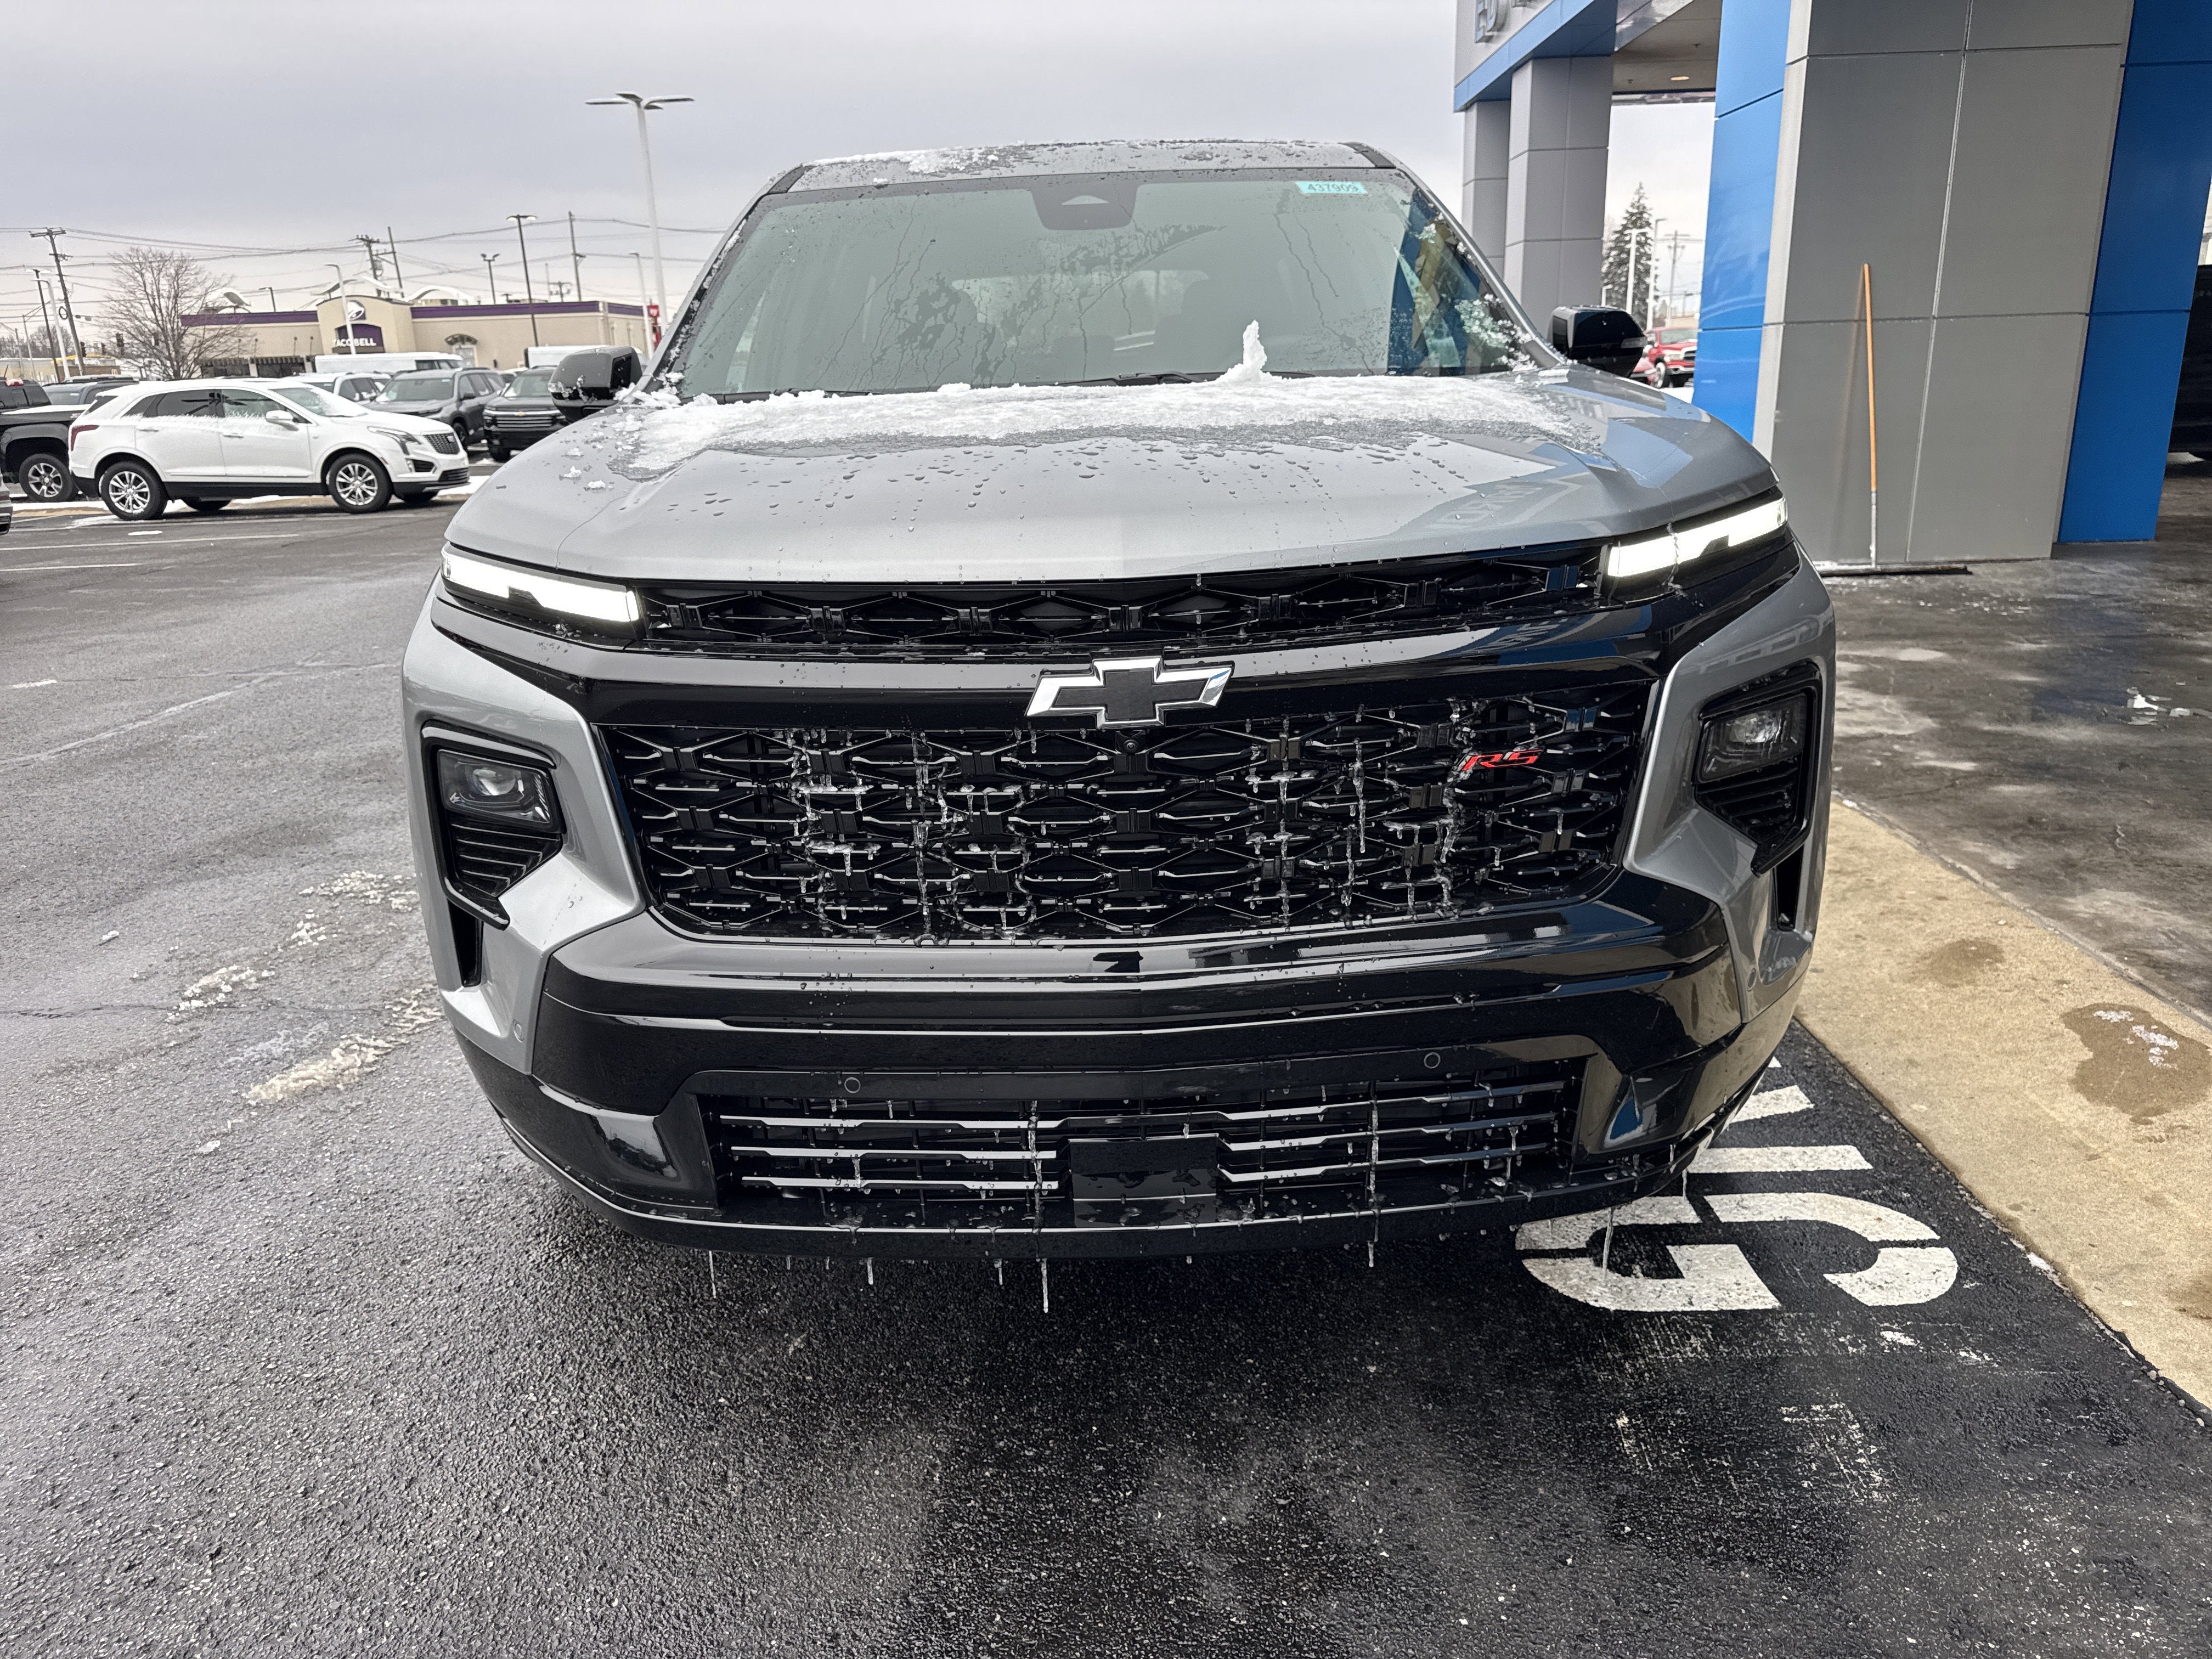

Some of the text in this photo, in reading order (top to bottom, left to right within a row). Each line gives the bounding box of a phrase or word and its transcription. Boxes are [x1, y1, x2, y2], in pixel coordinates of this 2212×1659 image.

[1307, 183, 1359, 193] 437909
[353, 337, 376, 346] BELL
[1456, 748, 1544, 771] RS
